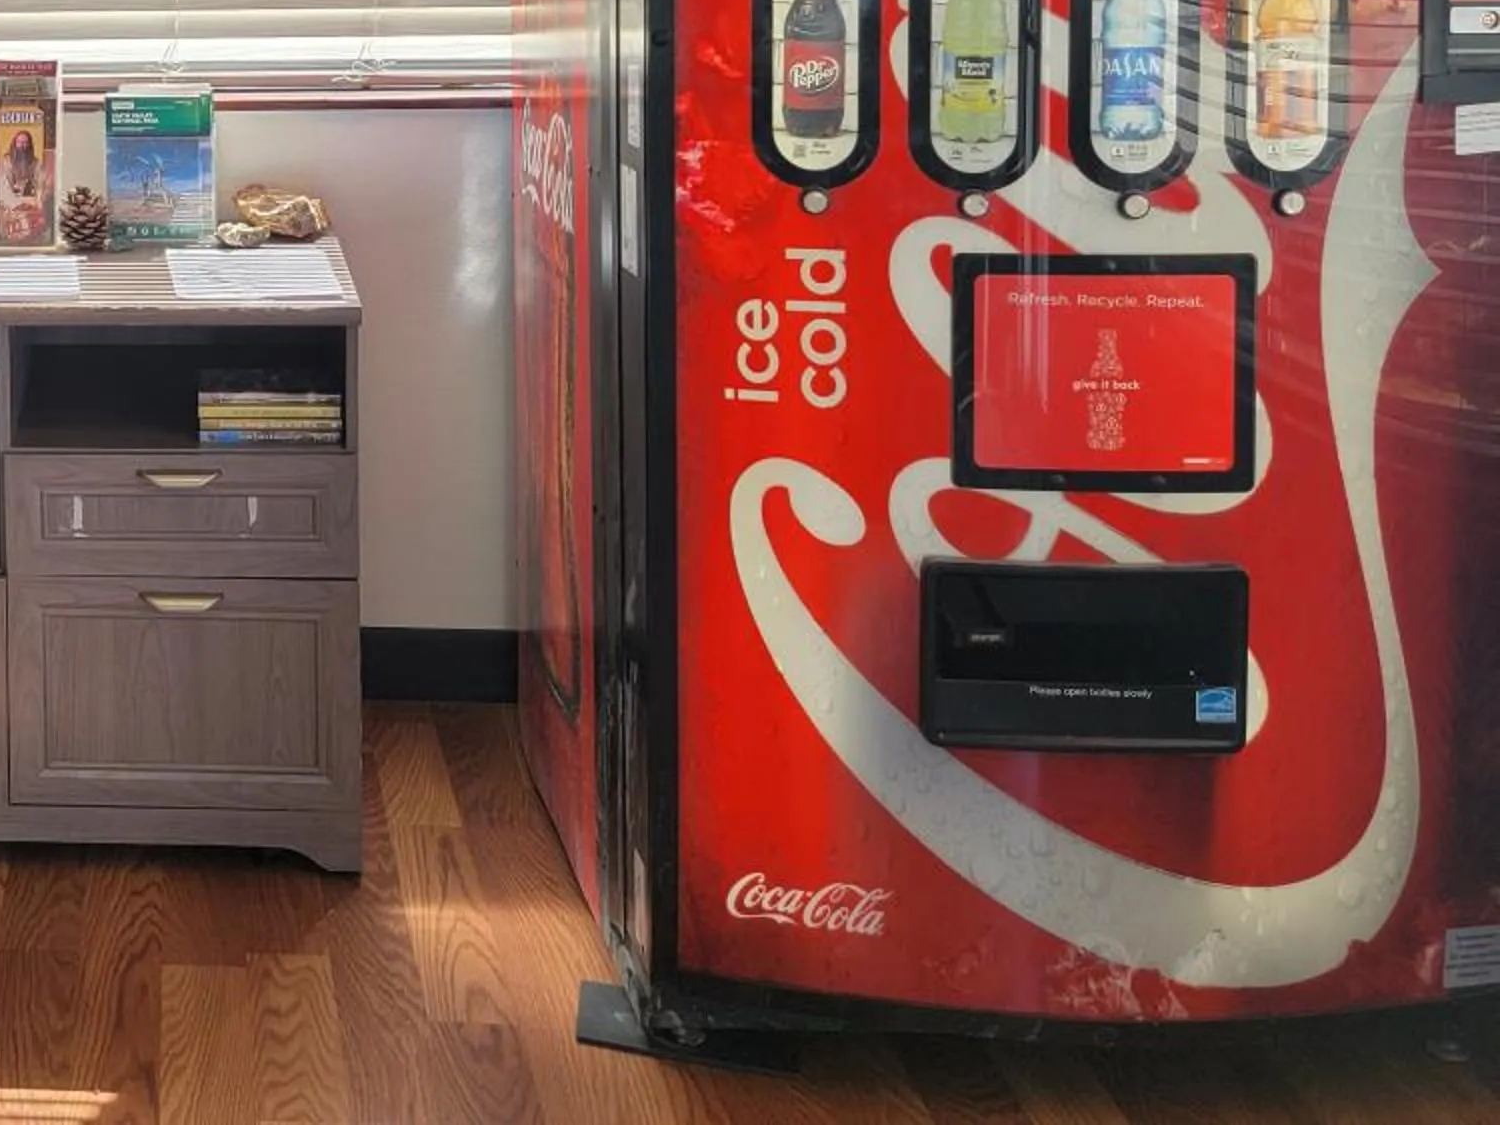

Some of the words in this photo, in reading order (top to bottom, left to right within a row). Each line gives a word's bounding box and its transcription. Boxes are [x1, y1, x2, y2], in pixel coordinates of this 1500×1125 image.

[1008, 292, 1069, 307] Refresh.
[1077, 293, 1141, 310] Recycle.
[1147, 294, 1205, 309] Repeat.
[785, 248, 848, 410] cold
[724, 298, 780, 403] ice
[1072, 379, 1099, 392] give
[1101, 379, 1110, 390] it
[1113, 379, 1141, 391] back
[1029, 685, 1061, 696] Please
[1064, 687, 1088, 699] open
[1123, 688, 1153, 700] slowly
[726, 872, 894, 936] Coca-Cola
